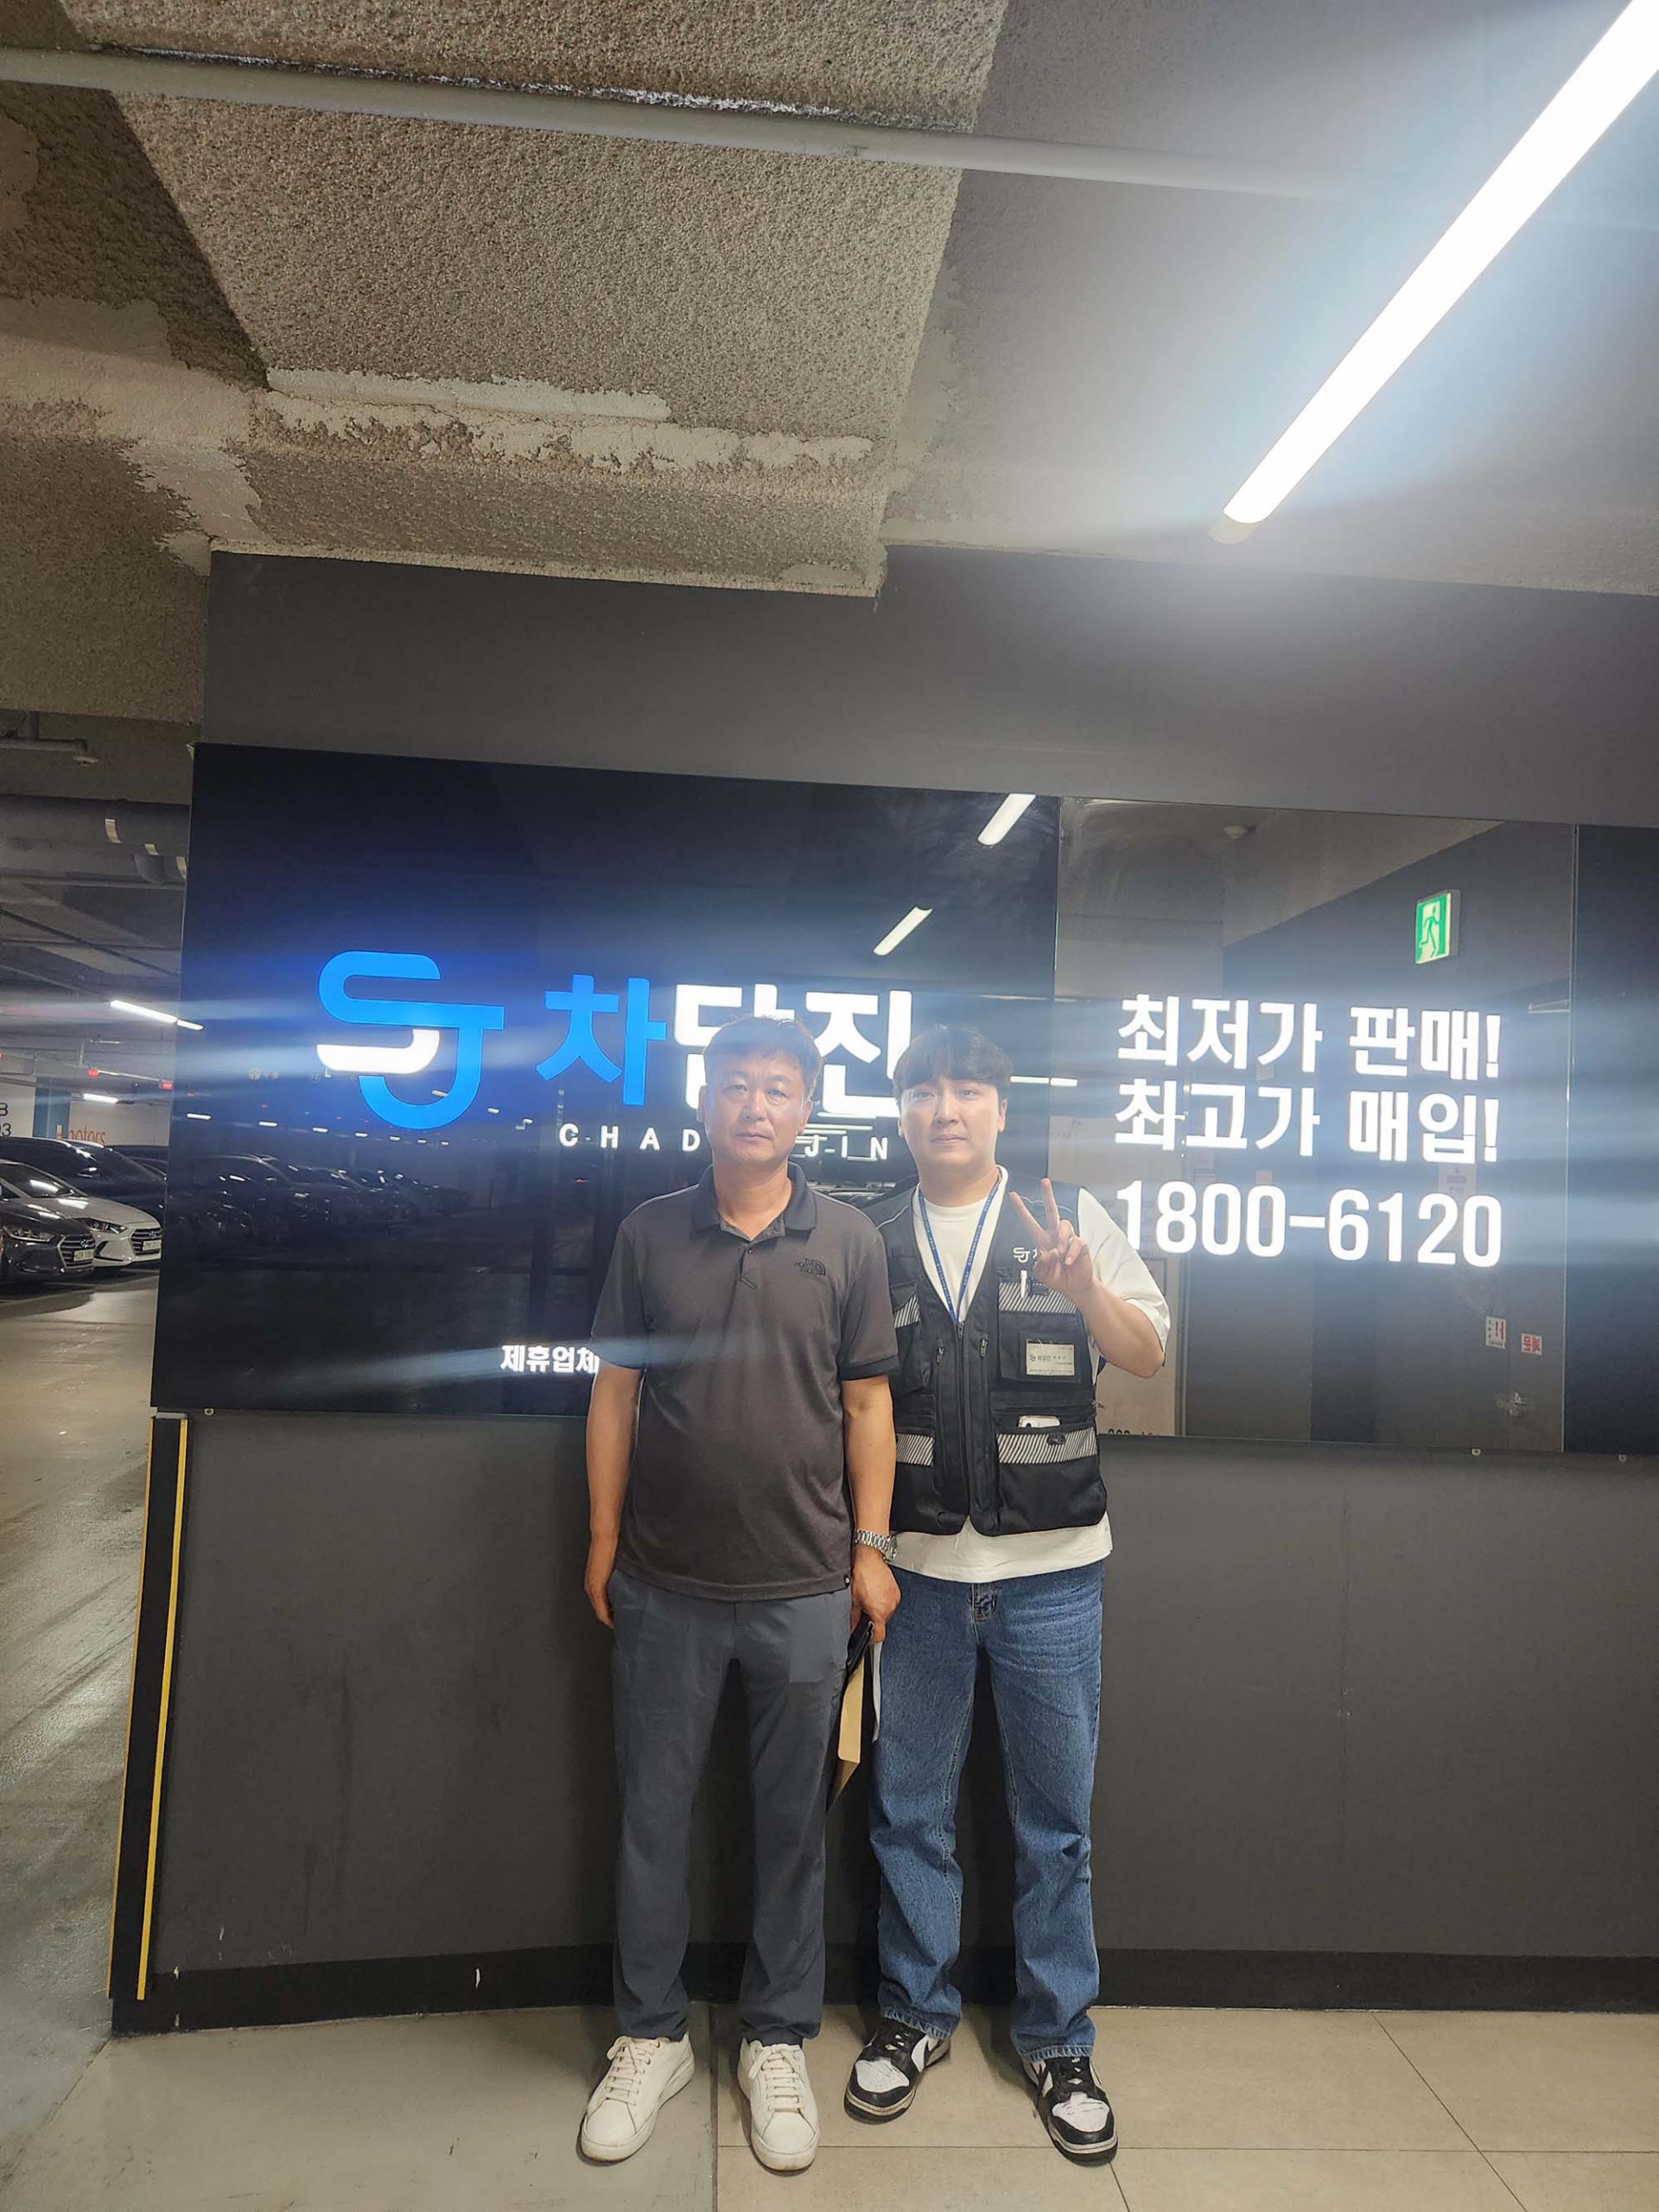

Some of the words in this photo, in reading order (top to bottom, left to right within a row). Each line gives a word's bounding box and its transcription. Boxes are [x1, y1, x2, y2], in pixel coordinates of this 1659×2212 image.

[1117, 994, 1323, 1073] 최저가
[1349, 1006, 1501, 1080] 판매!
[0, 1122, 11, 1136] 3
[558, 1122, 888, 1160] CHADJIN
[1115, 1078, 1320, 1156] 최고가
[1348, 1090, 1499, 1164] 매입!
[1116, 1179, 1502, 1268] 1800-6120
[499, 1344, 600, 1374] 제휴업체
